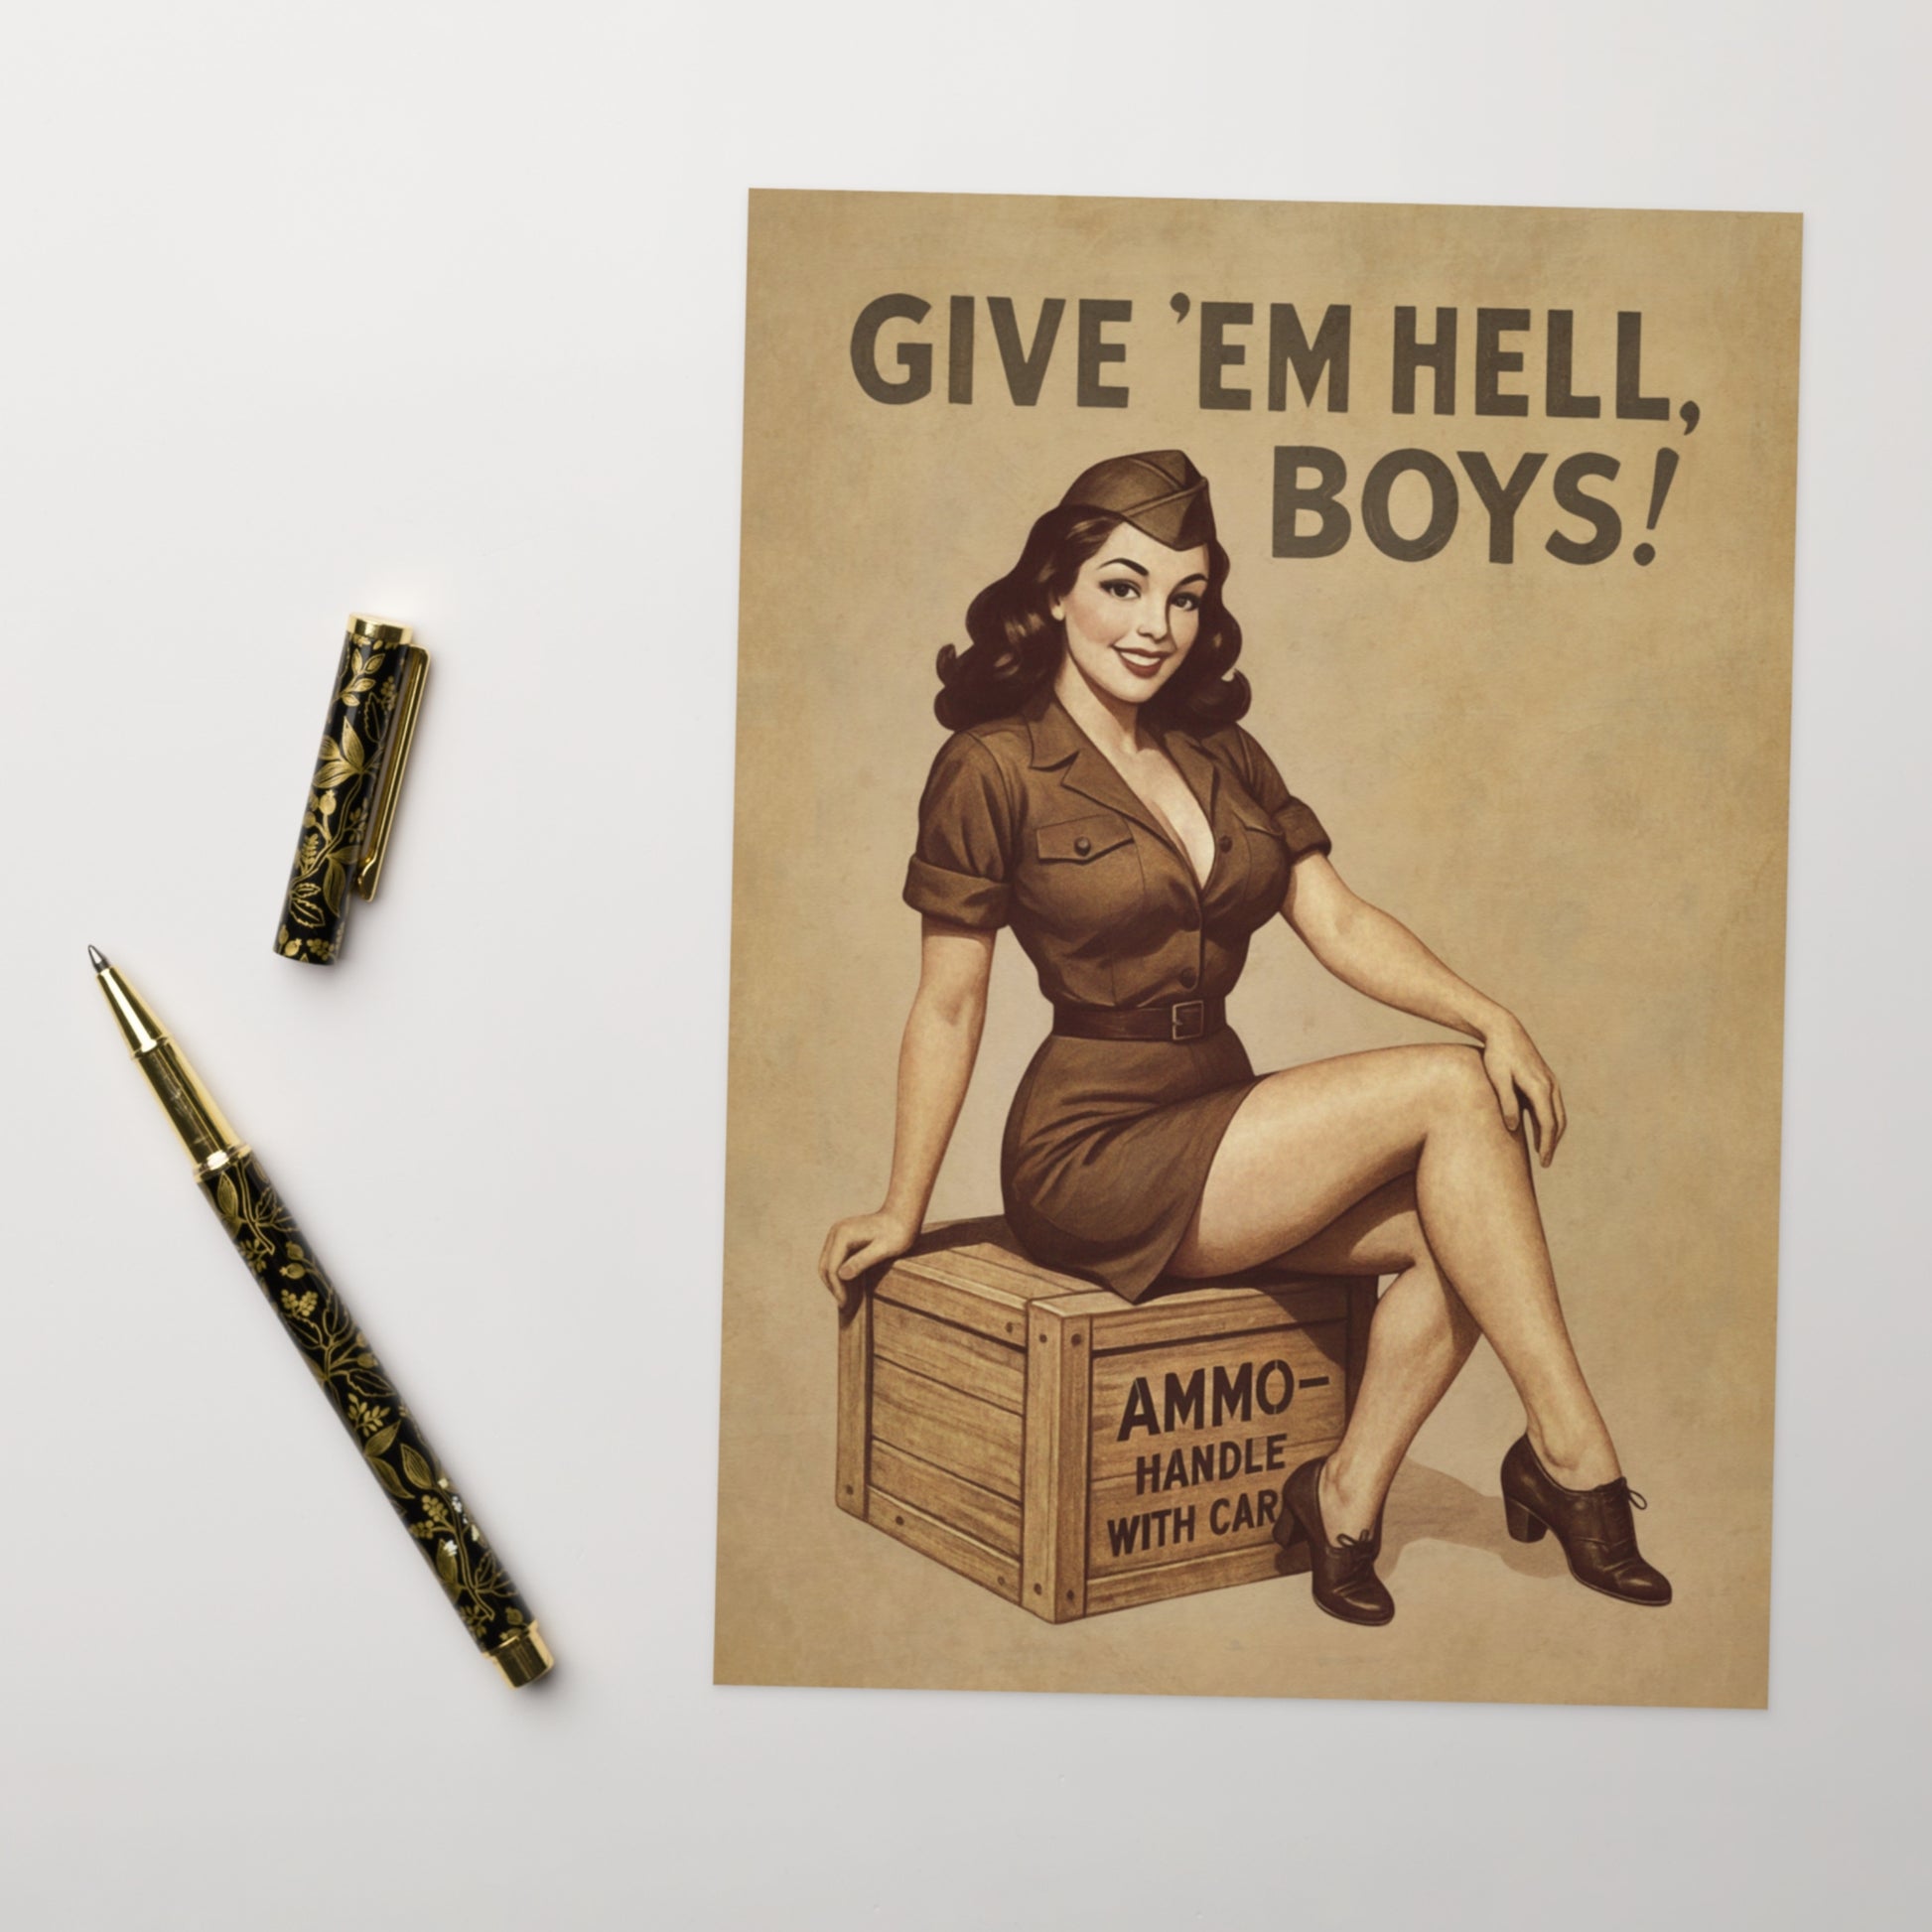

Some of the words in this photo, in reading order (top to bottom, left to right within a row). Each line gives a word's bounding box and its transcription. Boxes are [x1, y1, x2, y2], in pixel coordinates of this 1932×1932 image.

[849, 292, 1133, 408] GIVE
[1170, 292, 1352, 413] 'EM
[1392, 305, 1702, 437] HELL,
[1271, 444, 1681, 567] BOYS!
[1136, 1433, 1288, 1495] HANDLE
[1107, 1504, 1196, 1557] WITH
[1209, 1489, 1280, 1536] CAR
